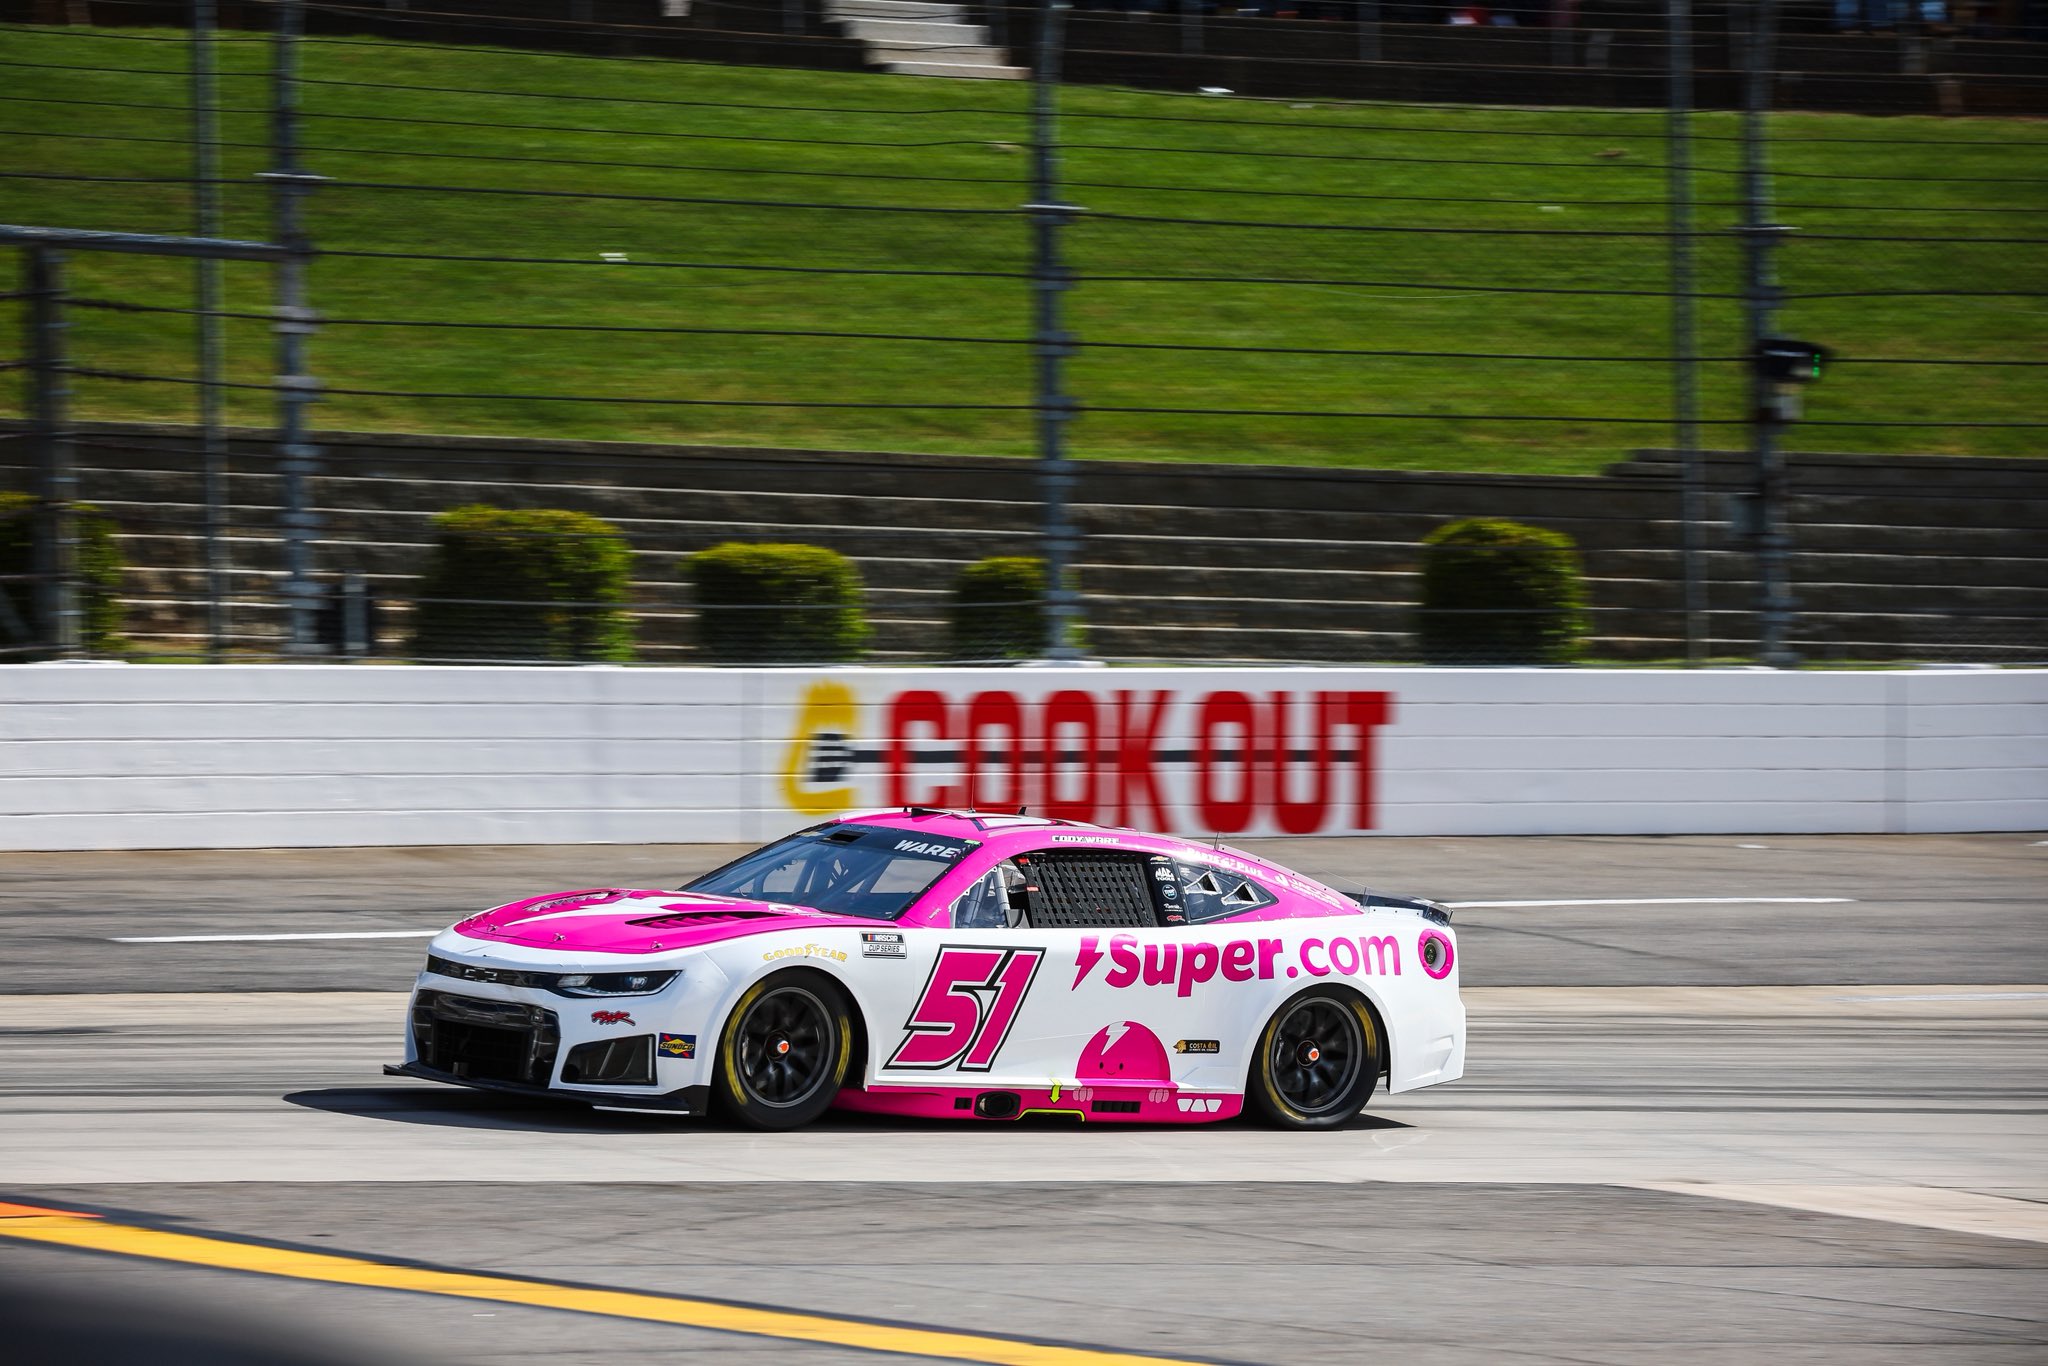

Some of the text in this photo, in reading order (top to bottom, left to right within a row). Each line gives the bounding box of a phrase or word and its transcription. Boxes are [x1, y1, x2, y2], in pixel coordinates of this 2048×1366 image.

[894, 840, 961, 858] WARE
[875, 934, 898, 943] NASCAR
[1104, 933, 1402, 998] Super.com
[882, 944, 1047, 1073] 51
[660, 1042, 695, 1051] SUNOCO
